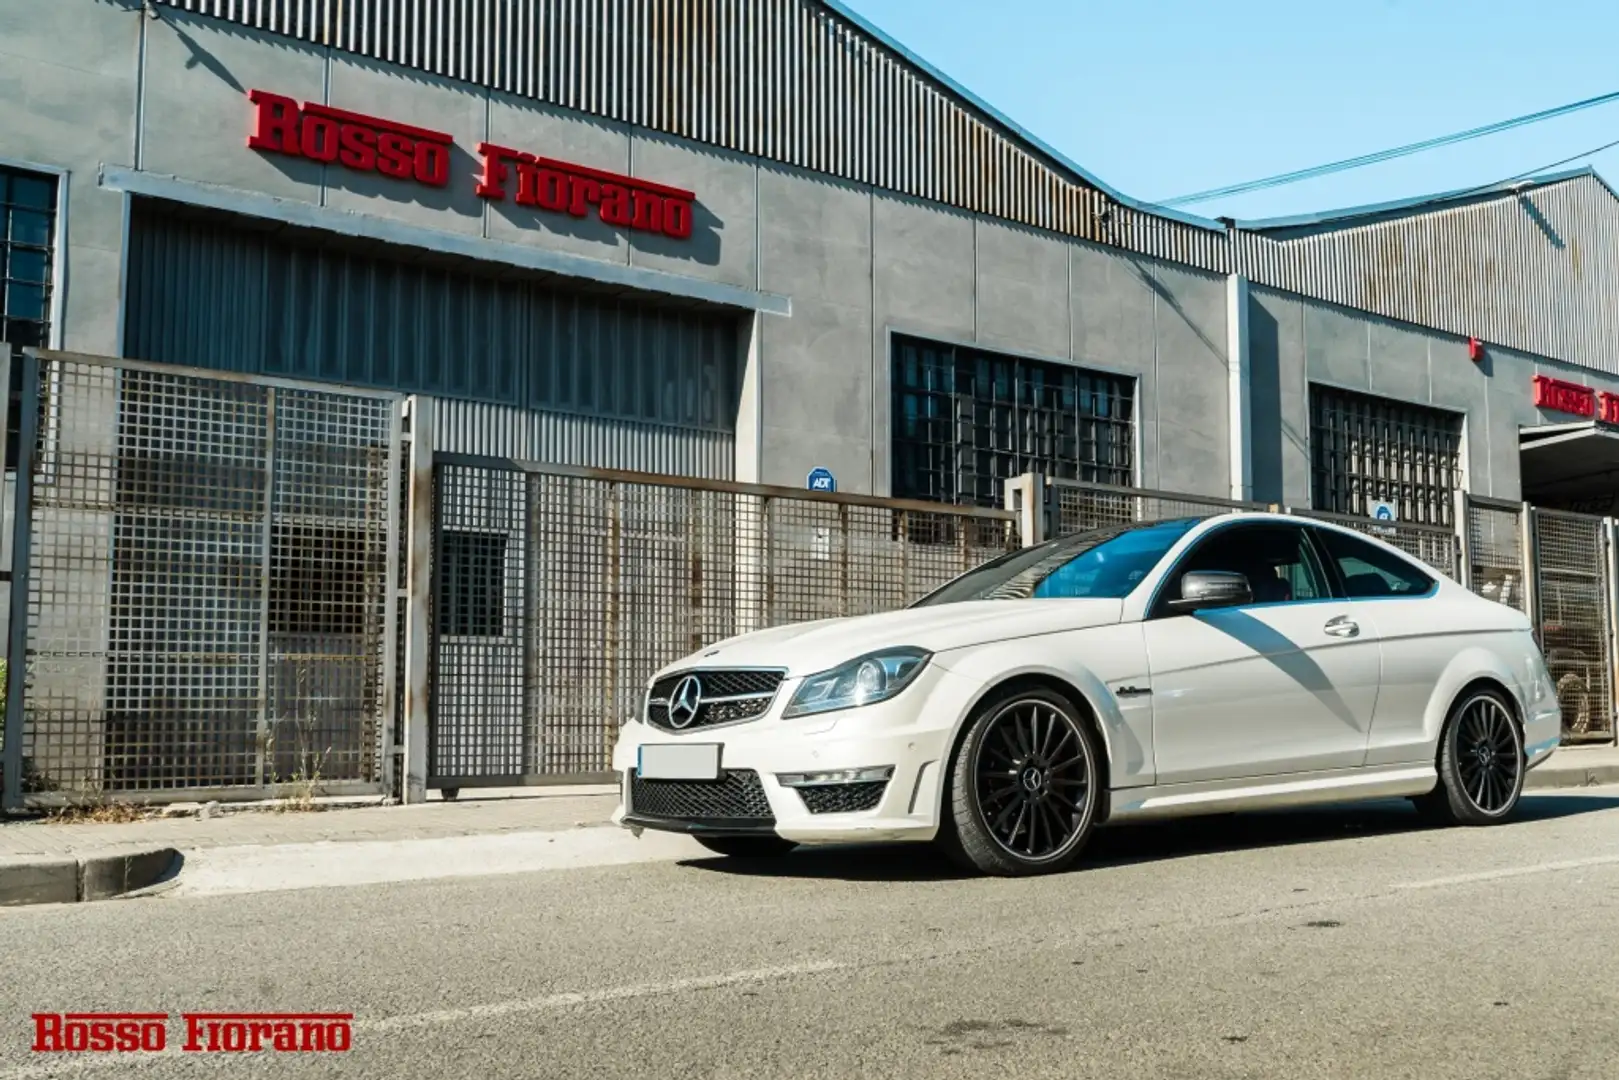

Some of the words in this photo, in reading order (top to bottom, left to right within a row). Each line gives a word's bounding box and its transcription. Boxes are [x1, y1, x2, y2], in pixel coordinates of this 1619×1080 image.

[247, 89, 453, 186] Rosso
[475, 142, 695, 239] Fiorano
[811, 477, 832, 489] ADT
